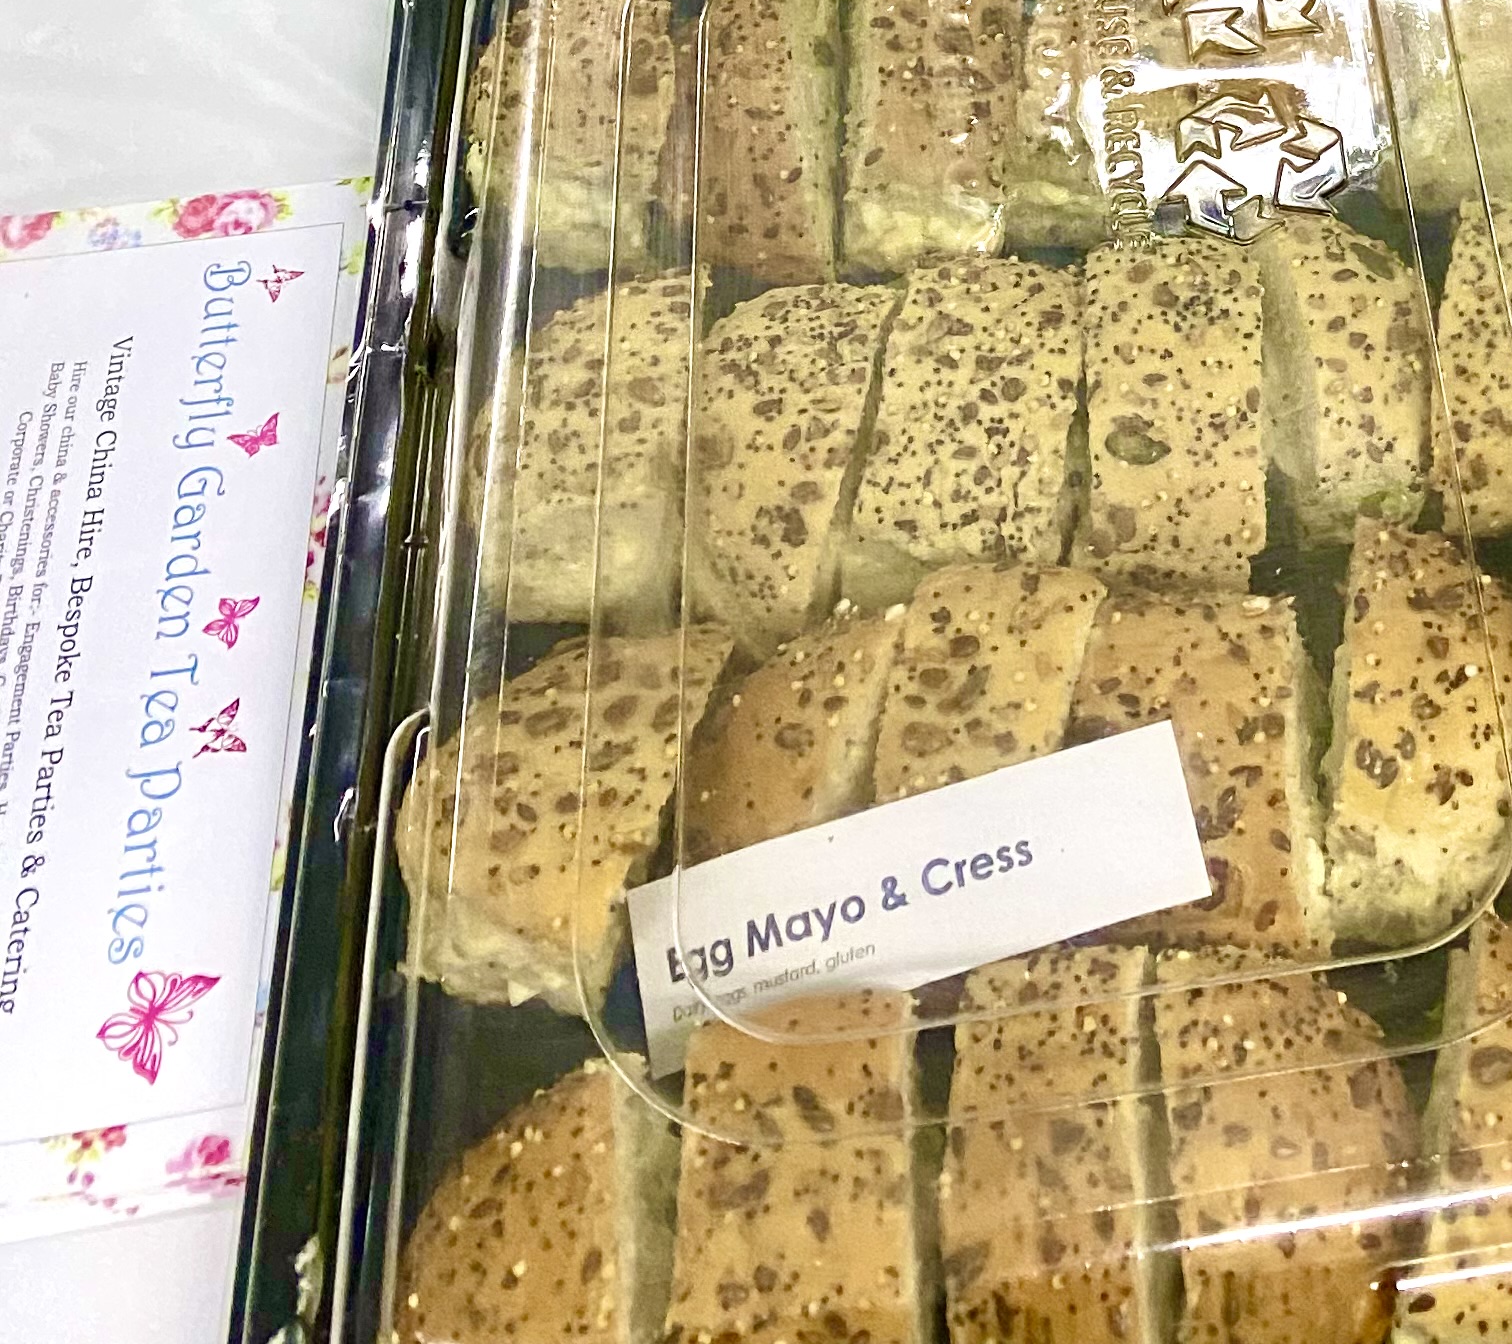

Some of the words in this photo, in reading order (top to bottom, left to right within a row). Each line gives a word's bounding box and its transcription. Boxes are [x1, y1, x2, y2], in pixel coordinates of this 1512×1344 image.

[1099, 67, 1136, 99] &
[1103, 110, 1153, 250] RECYCLE
[42, 362, 65, 399] Baby
[69, 361, 88, 392] Hire
[96, 335, 134, 422] Vintage
[172, 260, 252, 450] Butterfly
[30, 403, 57, 471] Showers,
[64, 395, 77, 421] our
[7, 411, 33, 486] Corporate
[52, 472, 67, 485] &
[55, 425, 75, 467] china
[85, 429, 117, 501] China
[3, 491, 14, 505] or
[10, 475, 44, 580] Christenings,
[35, 489, 61, 578] accessories
[70, 508, 105, 568] Hire,
[155, 465, 225, 640] Garden
[54, 575, 94, 683] Bespoke
[8, 621, 41, 726] Engagement
[139, 653, 200, 749] Tea
[44, 689, 75, 741] Tea
[26, 747, 64, 844] Parties
[20, 853, 46, 878] &
[107, 760, 183, 965] Parties
[666, 938, 735, 983] Egg
[746, 894, 866, 958] Mayo
[880, 875, 909, 912] &
[921, 839, 1034, 896] Cress
[0, 887, 39, 1014] Catering
[825, 943, 876, 973] gluten
